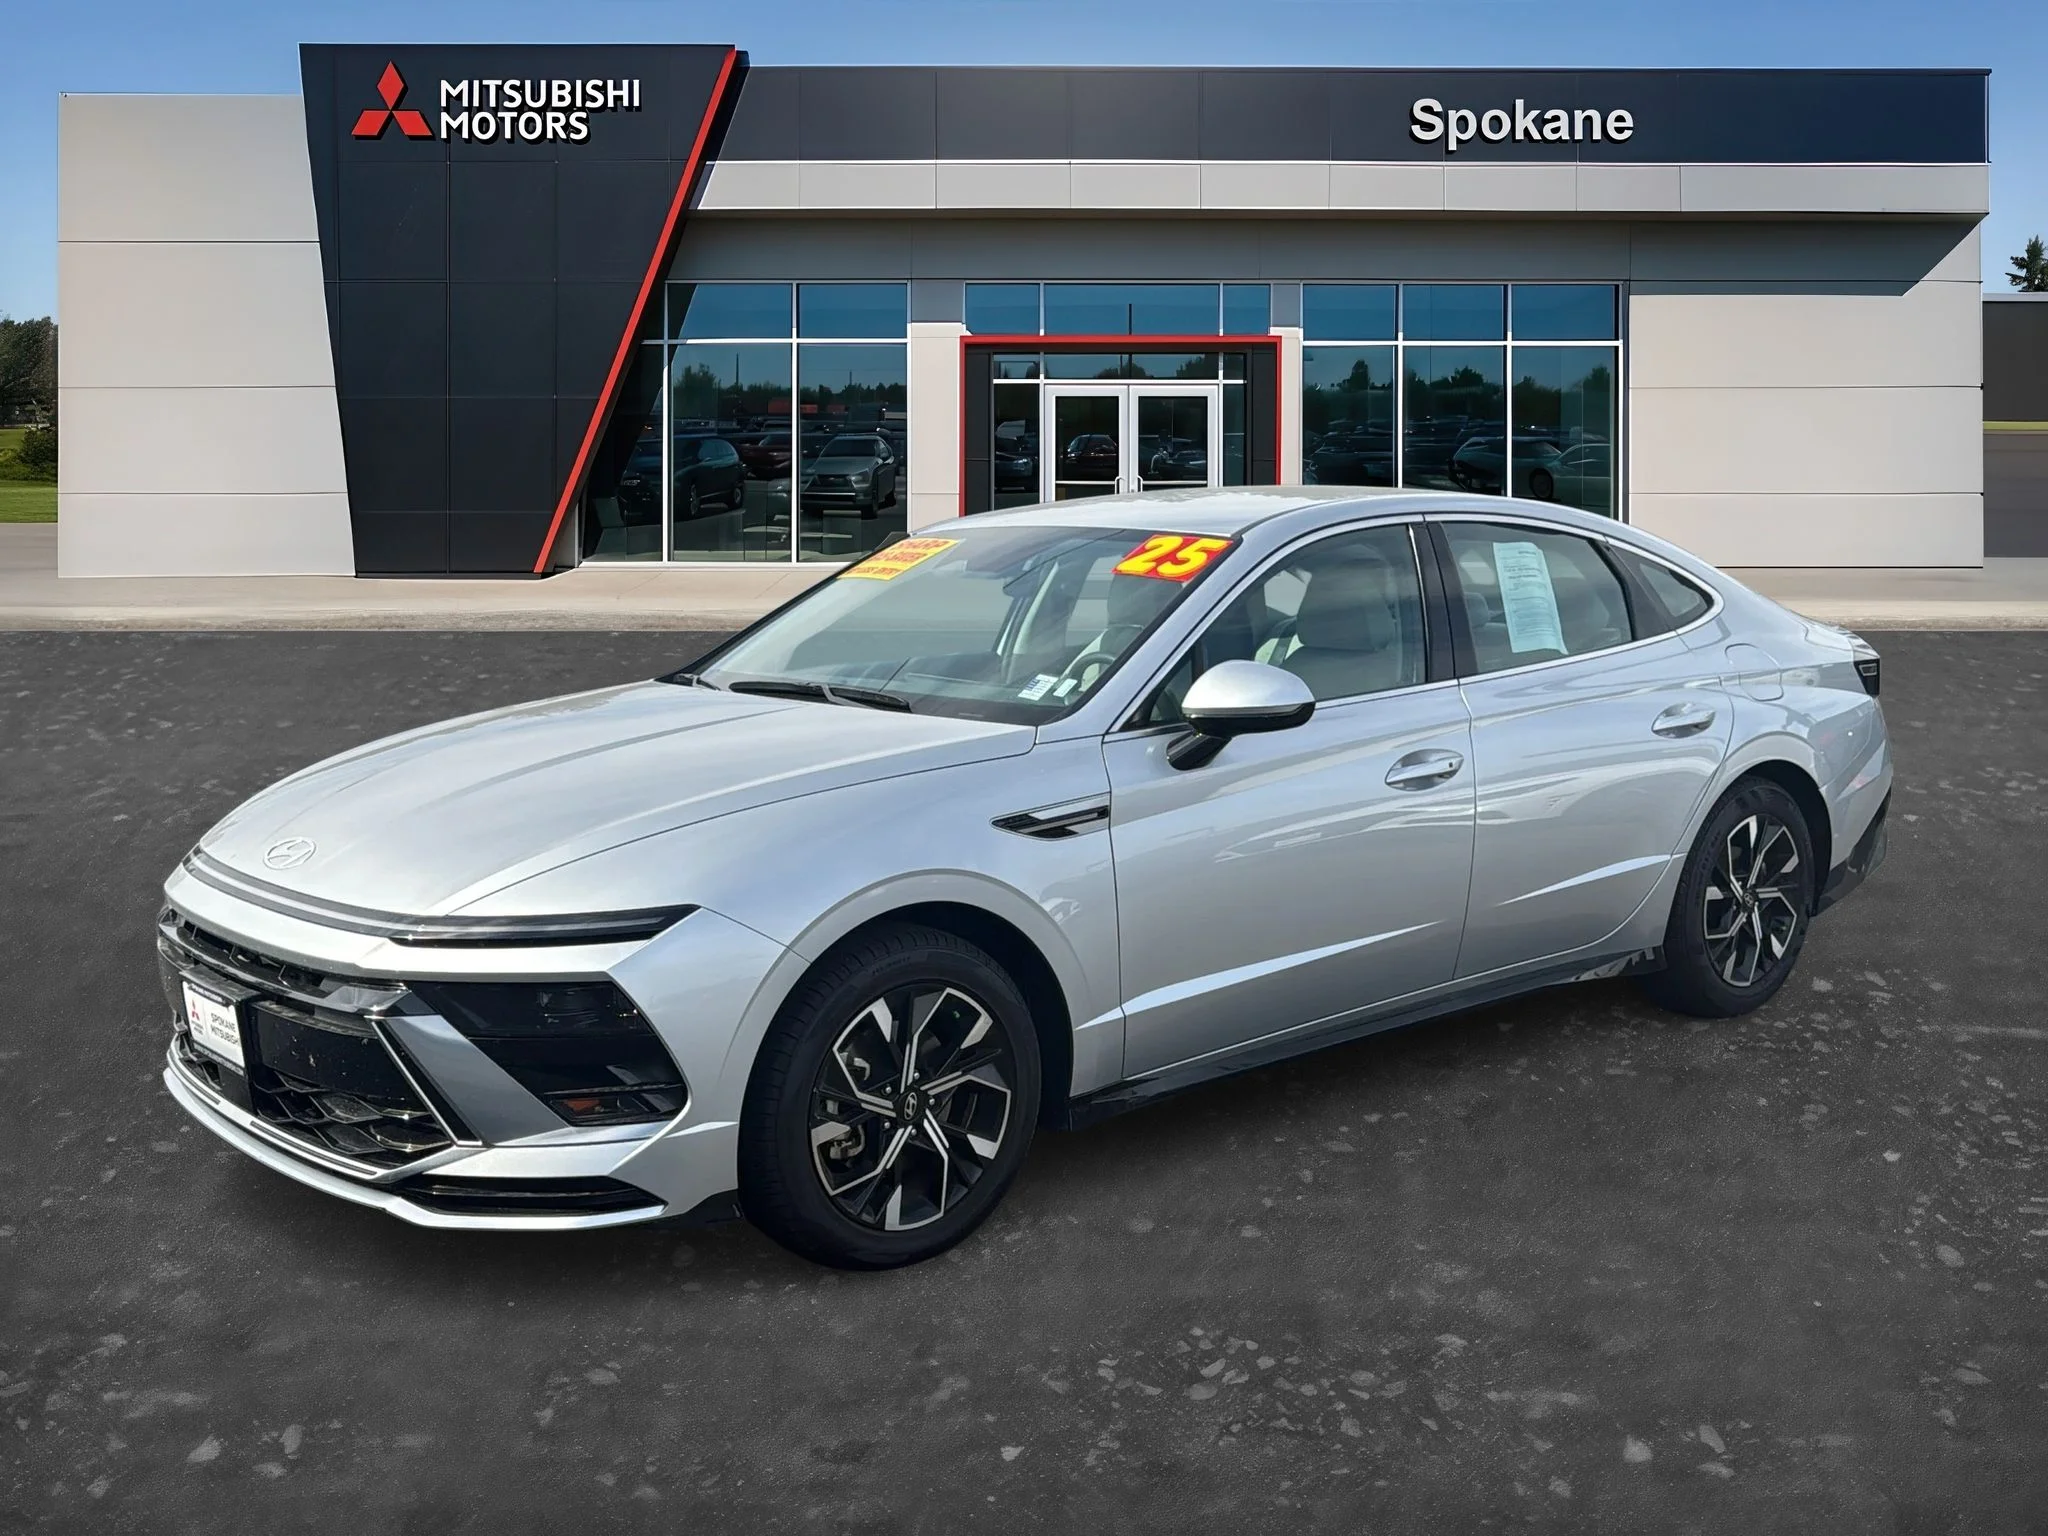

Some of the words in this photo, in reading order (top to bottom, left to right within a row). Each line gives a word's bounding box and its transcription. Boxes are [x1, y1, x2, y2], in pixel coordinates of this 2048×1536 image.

[440, 79, 640, 108] MITSUBISHI
[440, 111, 588, 140] MOTORS
[1411, 98, 1634, 151] Spokane
[1115, 535, 1229, 577] 25
[210, 1012, 236, 1032] SPOKANE
